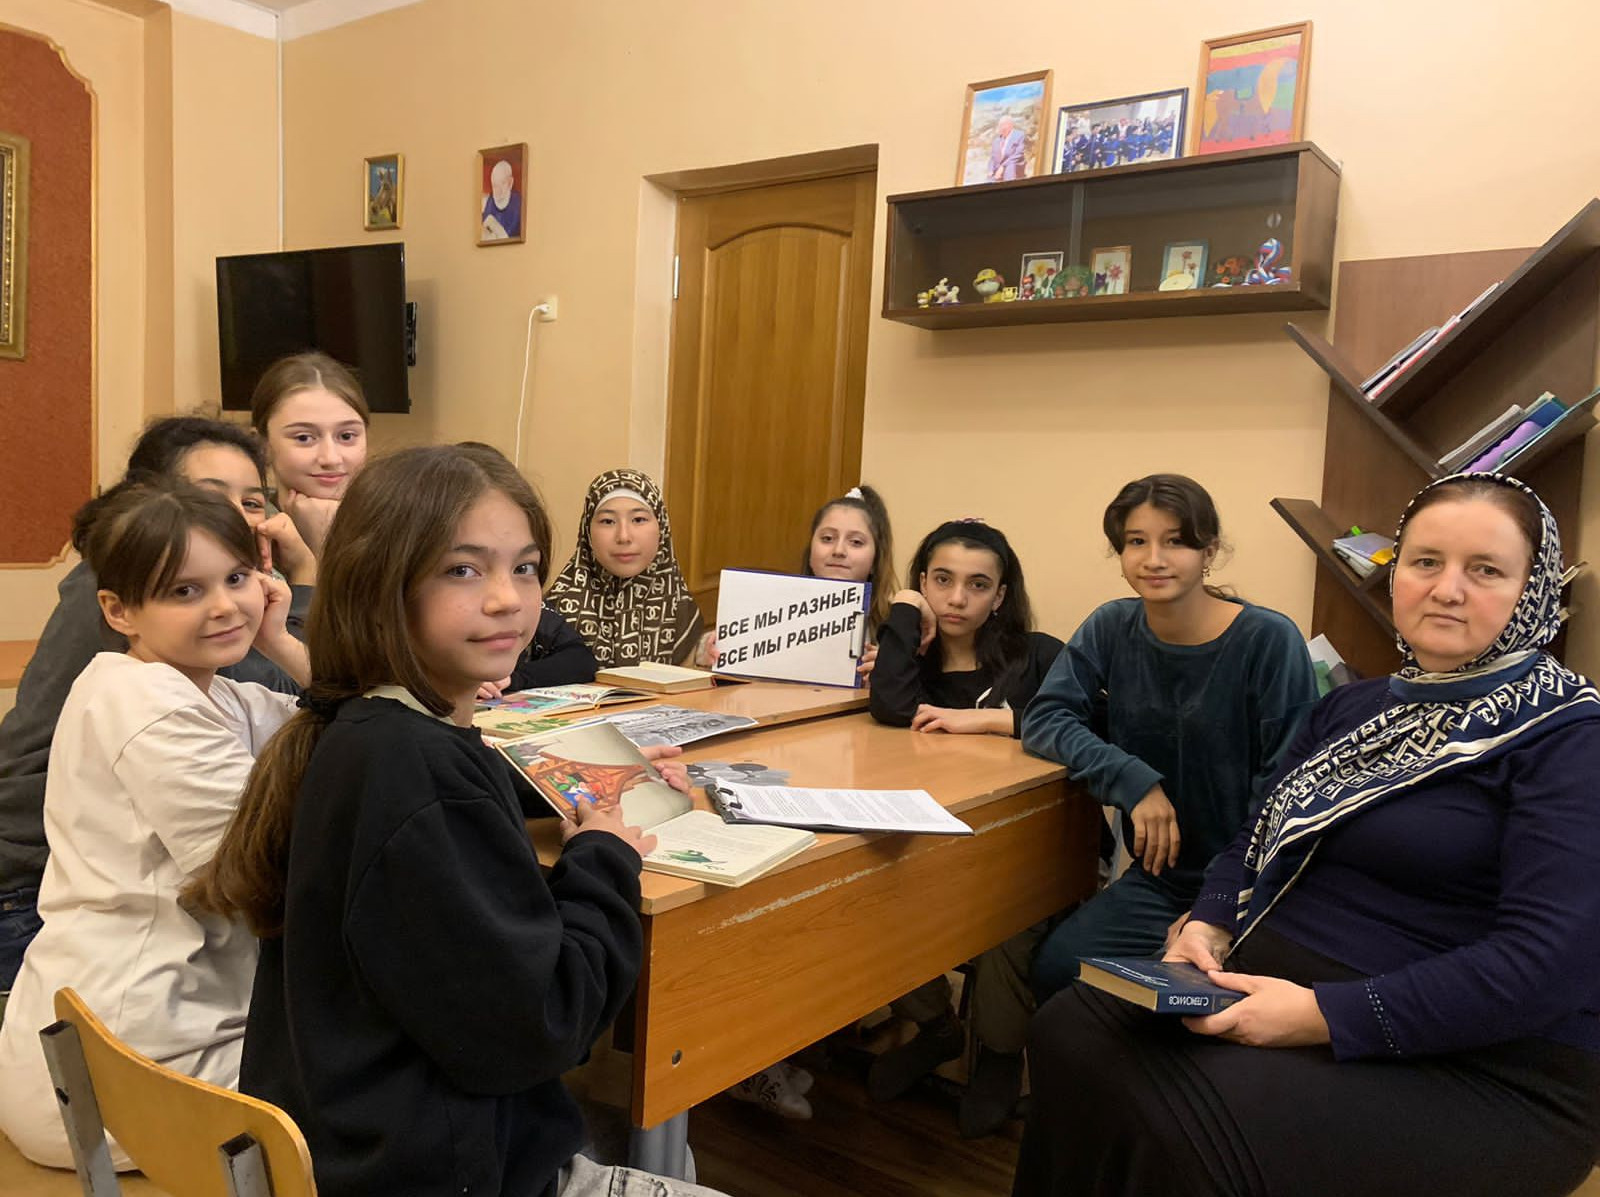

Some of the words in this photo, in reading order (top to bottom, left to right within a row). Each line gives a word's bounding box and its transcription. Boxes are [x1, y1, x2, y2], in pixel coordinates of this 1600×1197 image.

[718, 618, 750, 641] ВСЕ
[754, 608, 783, 630] МЫ
[788, 587, 861, 621] РАЗНЫЕ,
[716, 646, 748, 669] ВСЕ
[752, 636, 781, 659] МЫ
